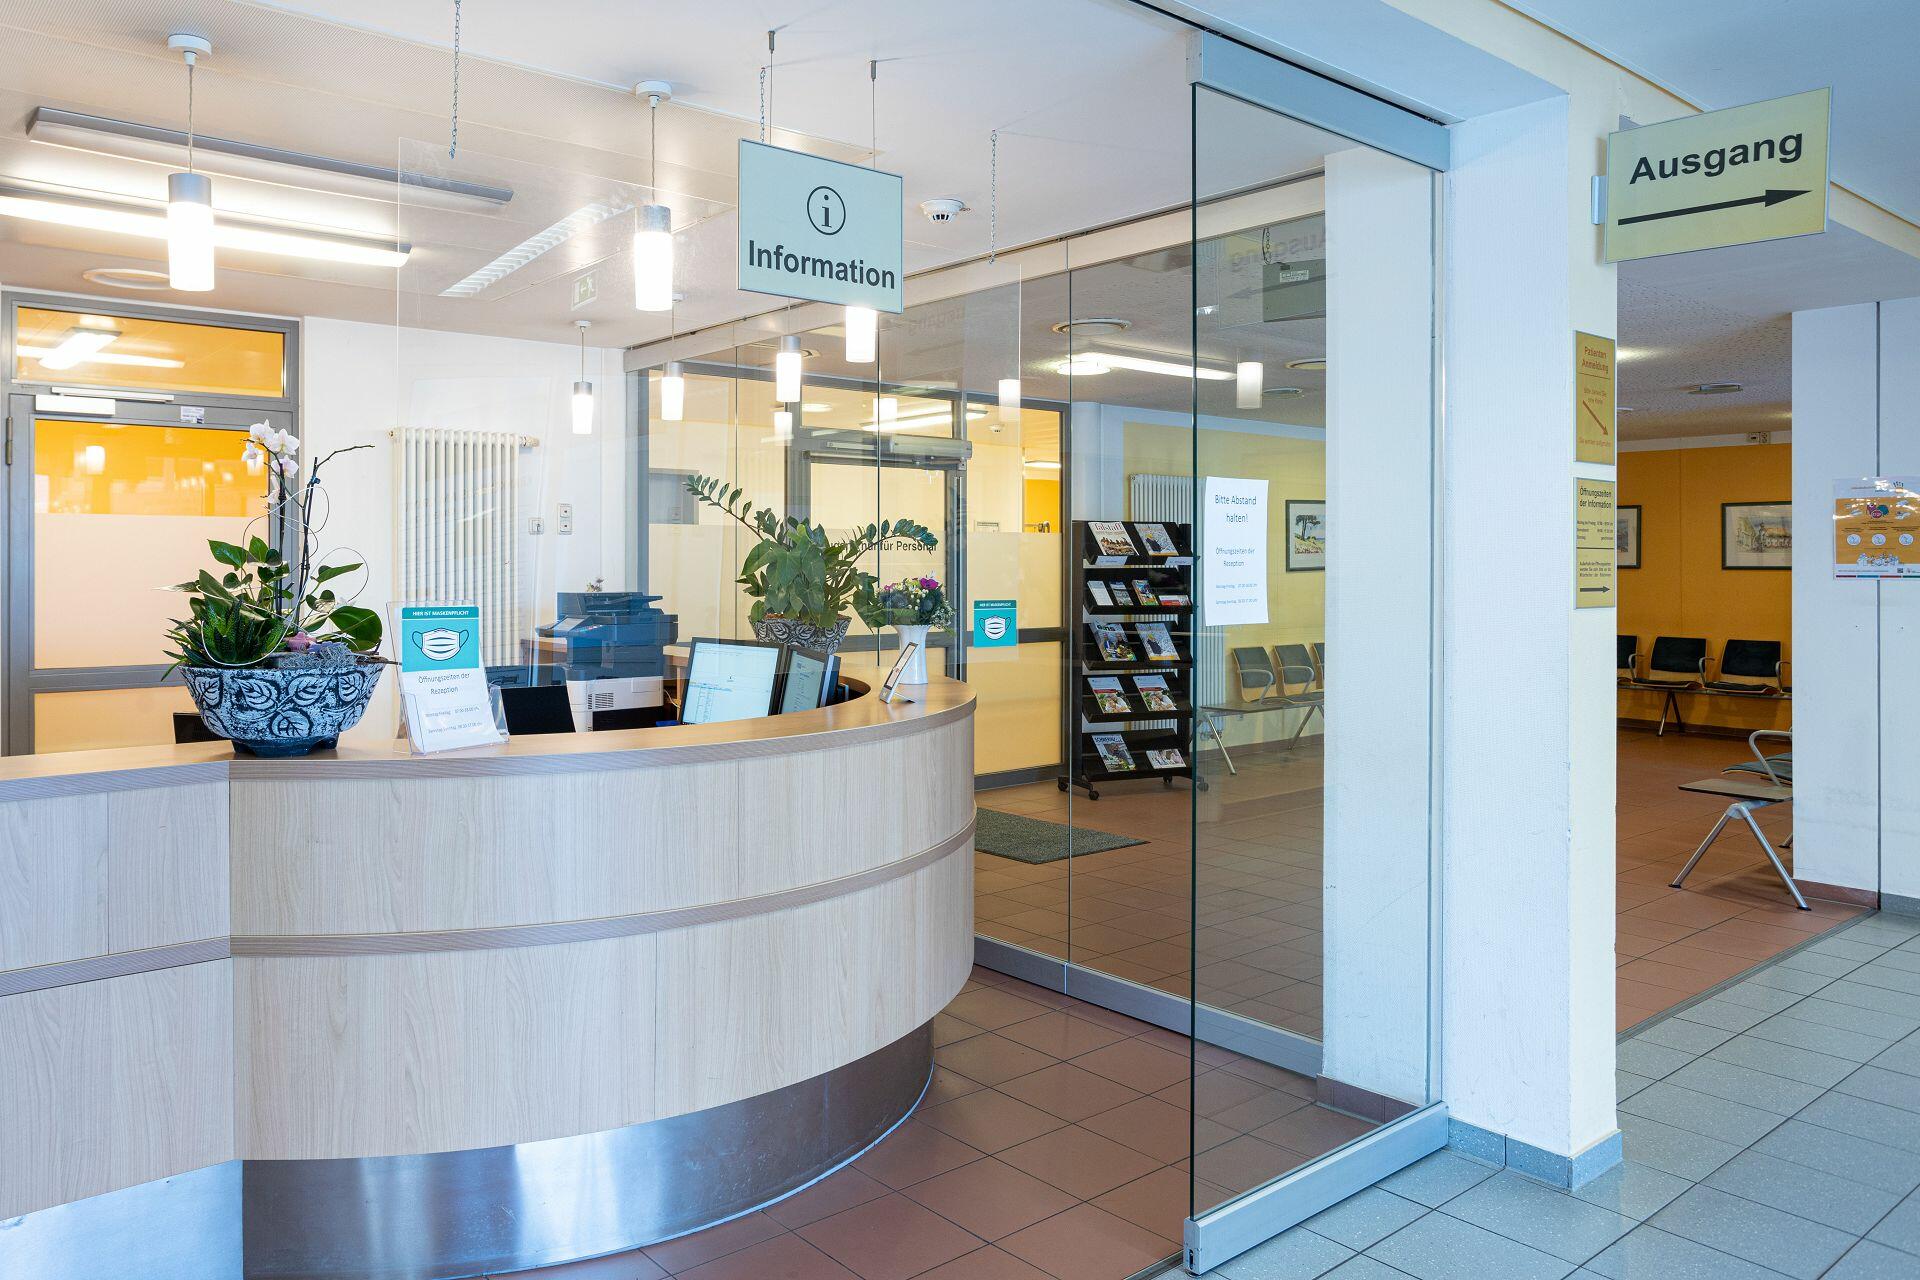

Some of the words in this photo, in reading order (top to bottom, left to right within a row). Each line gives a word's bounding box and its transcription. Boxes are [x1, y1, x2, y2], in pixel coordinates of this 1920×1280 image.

[1629, 132, 1803, 185] Ausgang
[749, 239, 895, 290] Information
[1215, 494, 1230, 505] Bitte
[1231, 495, 1257, 505] Abstand
[1226, 513, 1249, 523] halten!
[418, 673, 460, 684] Öffnungszeiten
[461, 672, 470, 680] der
